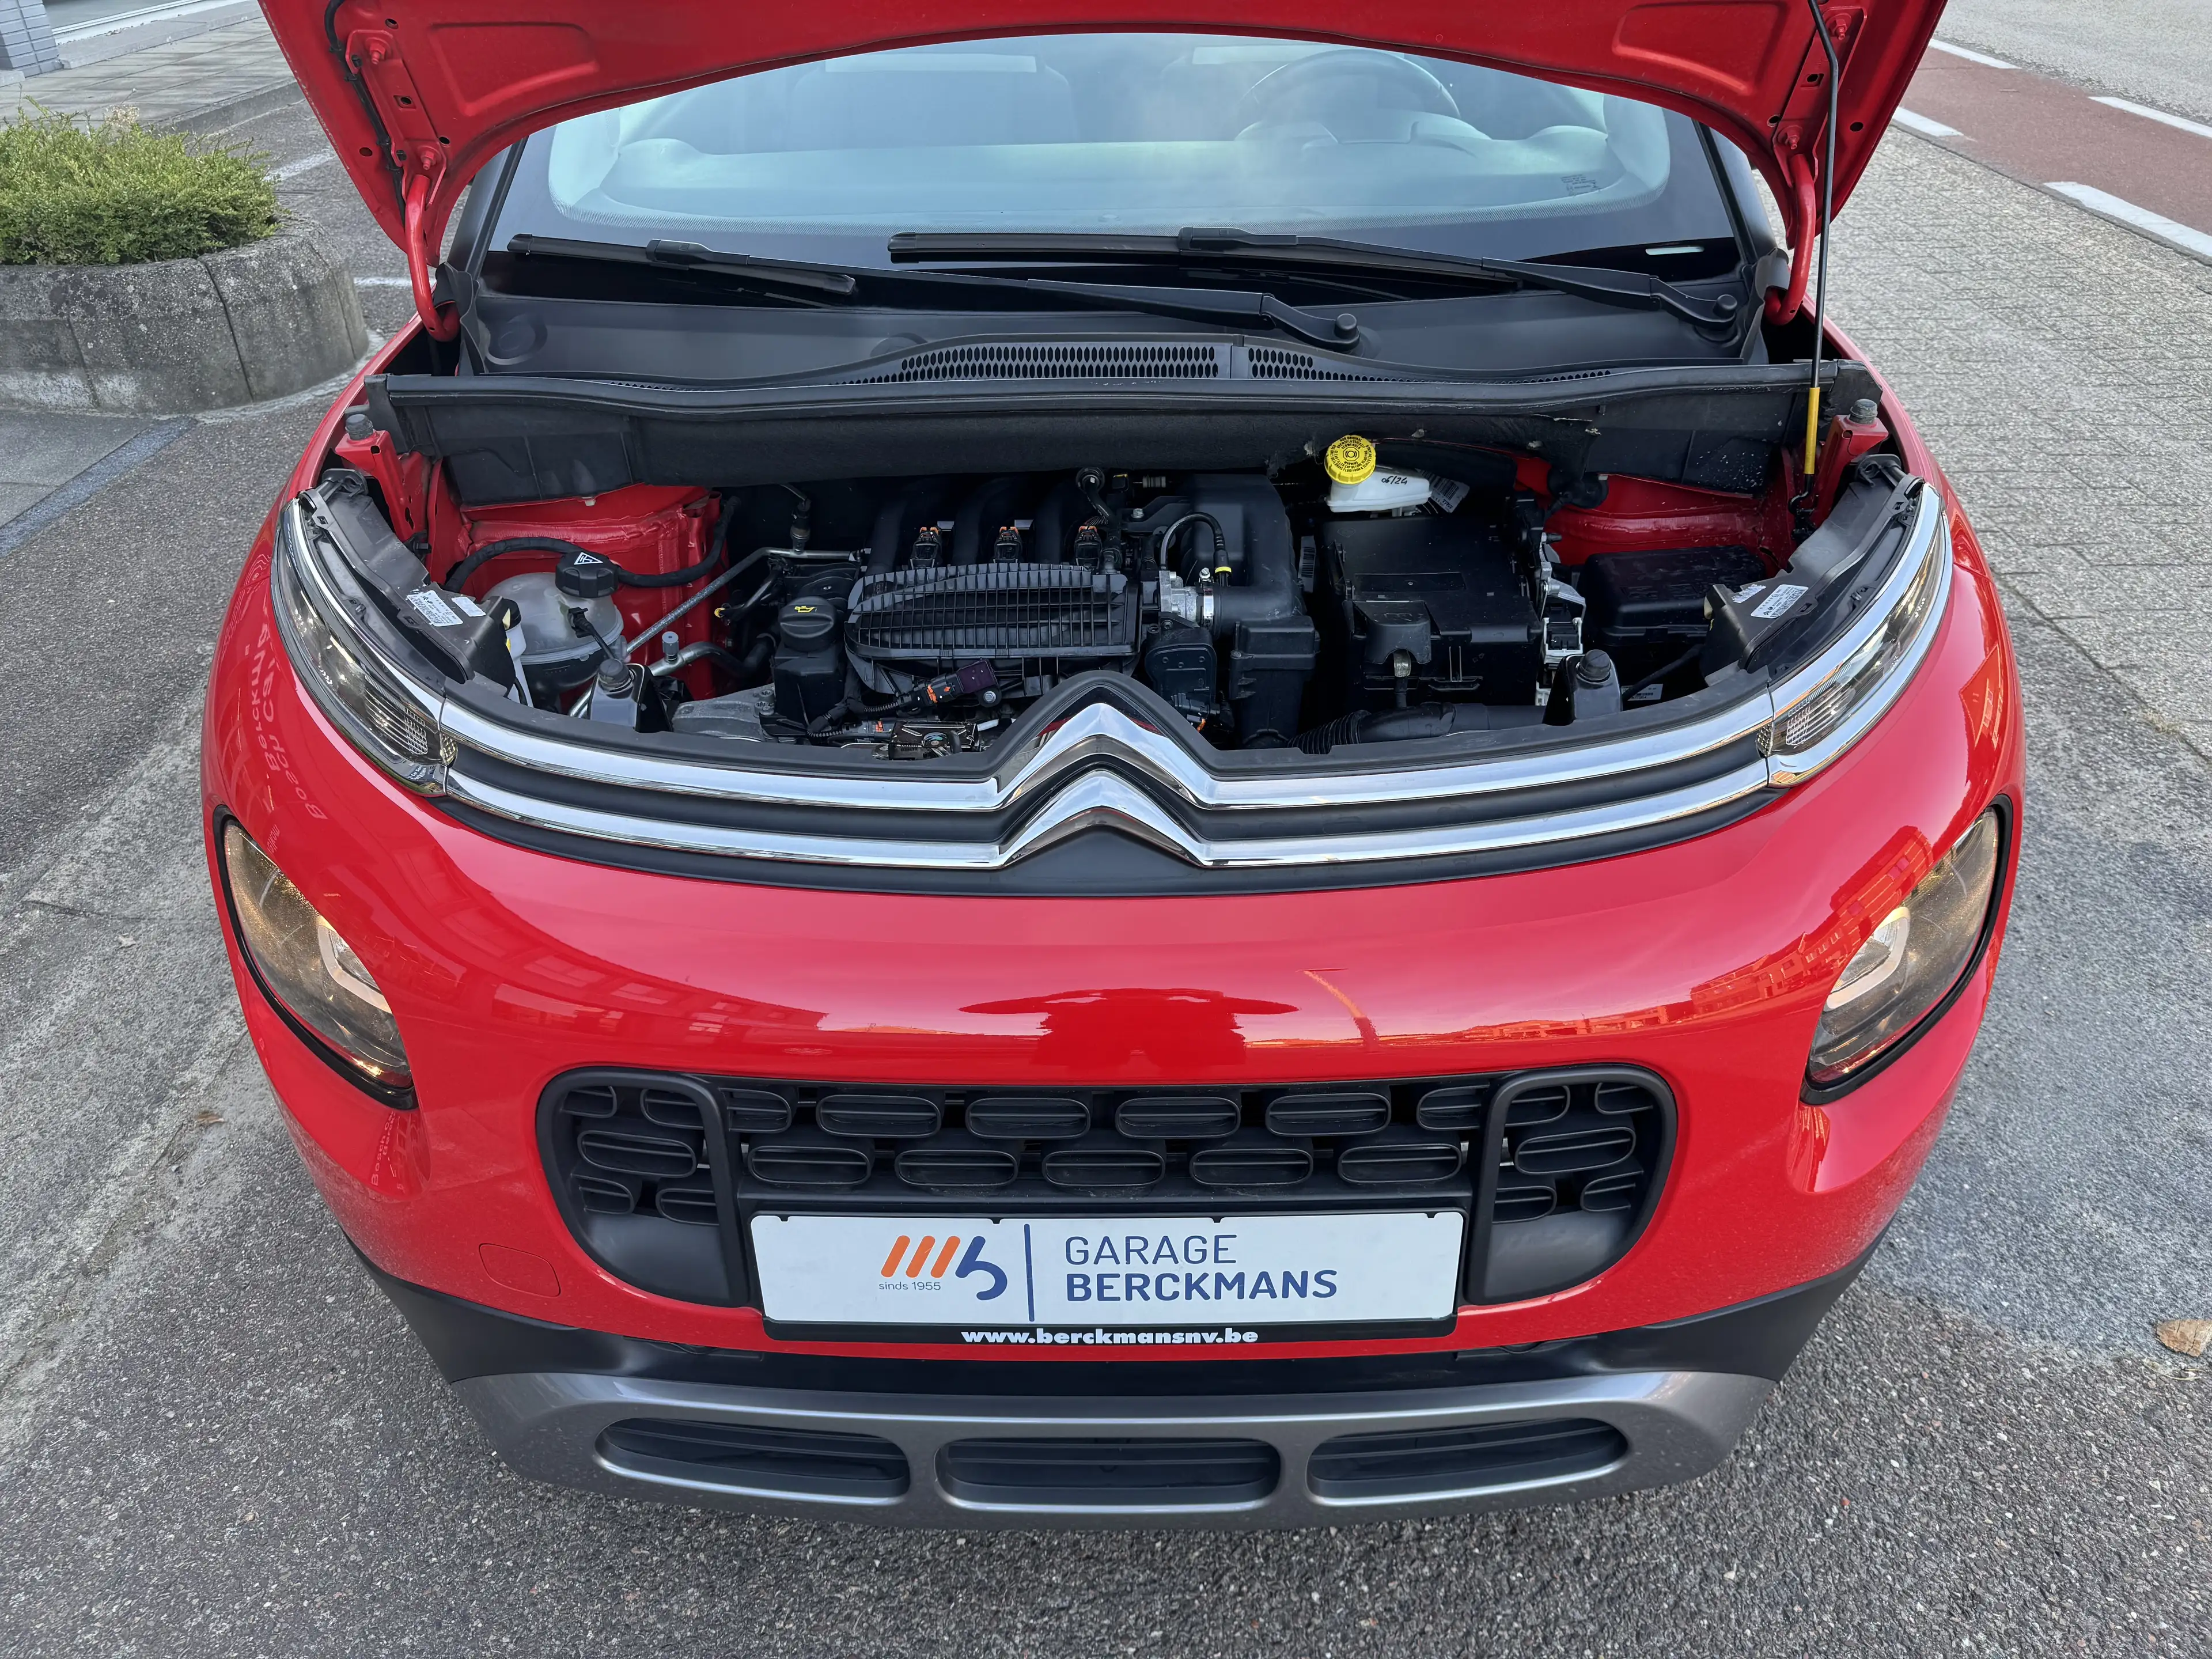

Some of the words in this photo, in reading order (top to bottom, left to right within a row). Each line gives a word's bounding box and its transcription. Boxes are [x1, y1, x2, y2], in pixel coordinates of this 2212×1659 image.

[1065, 1234, 1237, 1266] GARAGE
[878, 1282, 908, 1290] sinds
[912, 1282, 941, 1290] 1955
[1066, 1270, 1338, 1302] BERCKMANS
[961, 1328, 1259, 1344] www.berckmansnv.be
